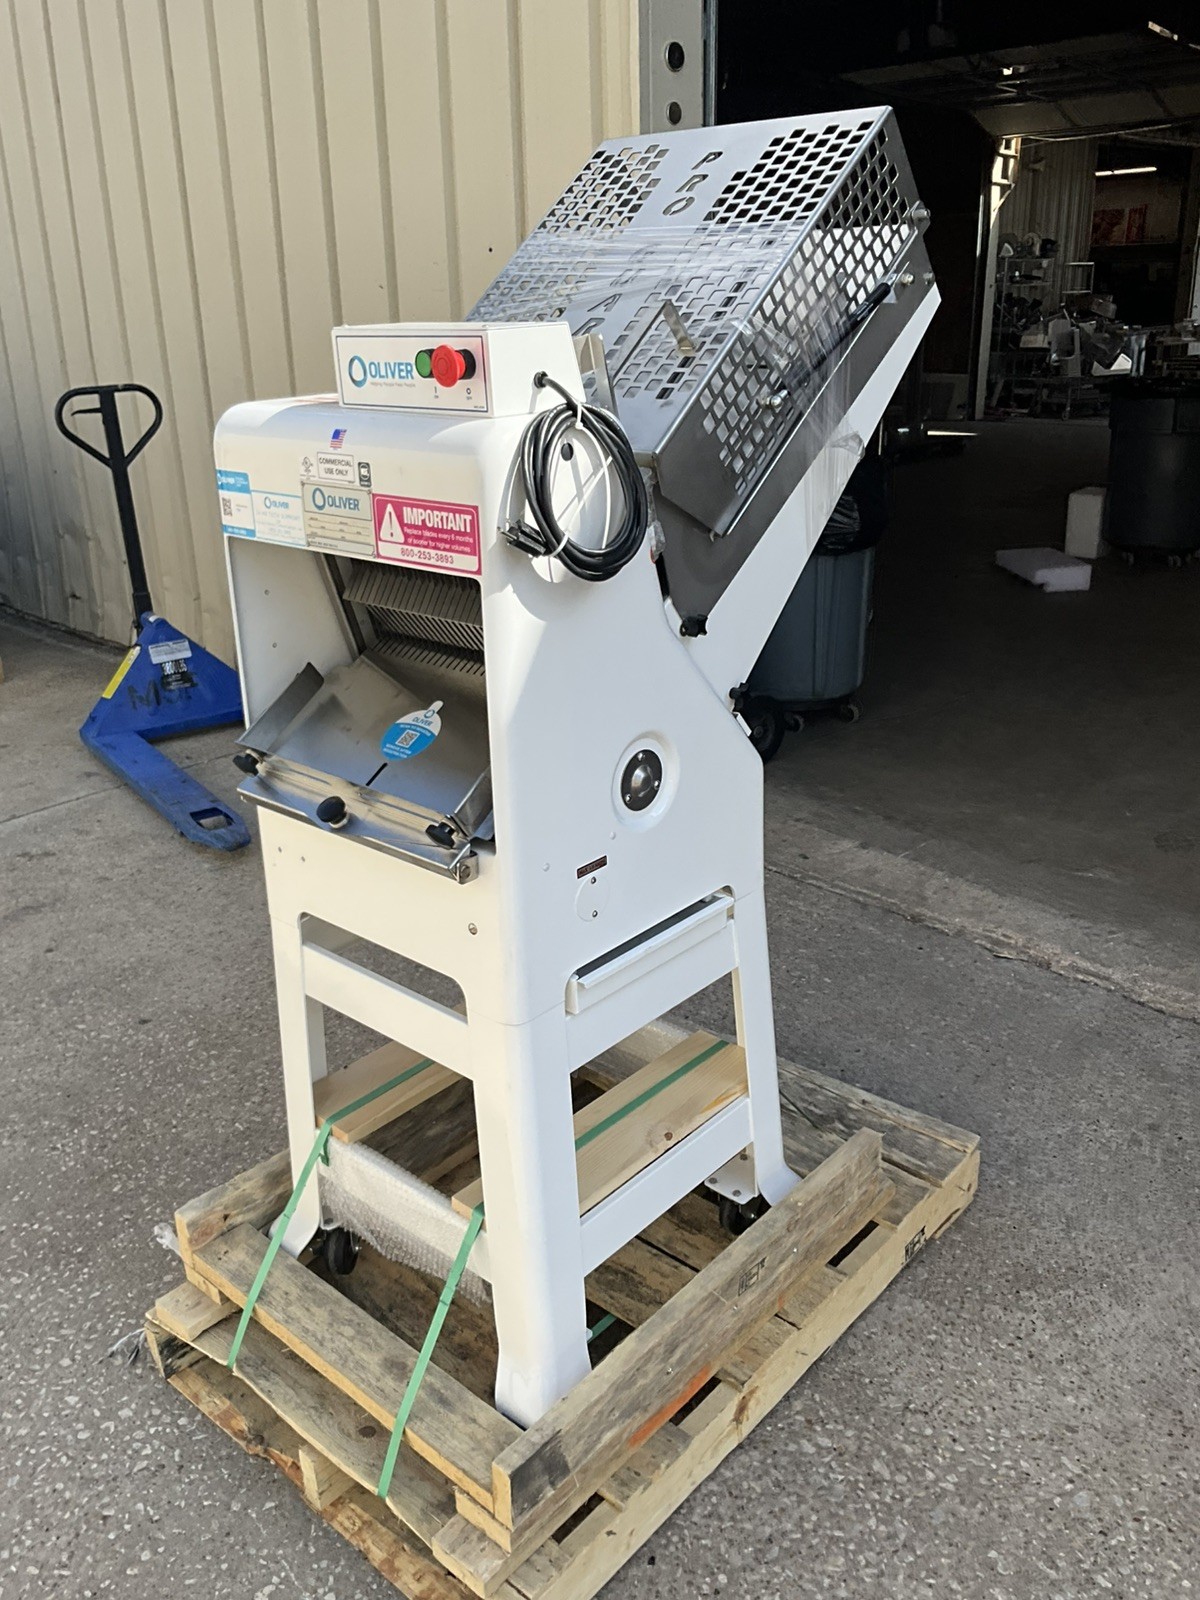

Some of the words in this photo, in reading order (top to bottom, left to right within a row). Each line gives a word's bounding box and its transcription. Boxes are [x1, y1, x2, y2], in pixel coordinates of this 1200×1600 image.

[662, 151, 724, 217] PRO
[368, 361, 414, 380] OLIVER
[319, 457, 353, 467] COMMERCIAL
[271, 500, 289, 510] OLIVER
[327, 495, 360, 512] OLIVER
[403, 506, 472, 533] IMPORTANT
[403, 526, 422, 536] Replace
[438, 533, 451, 541] every
[455, 535, 473, 544] months
[400, 547, 455, 565] 800-253-3893
[412, 717, 433, 726] OLIVER
